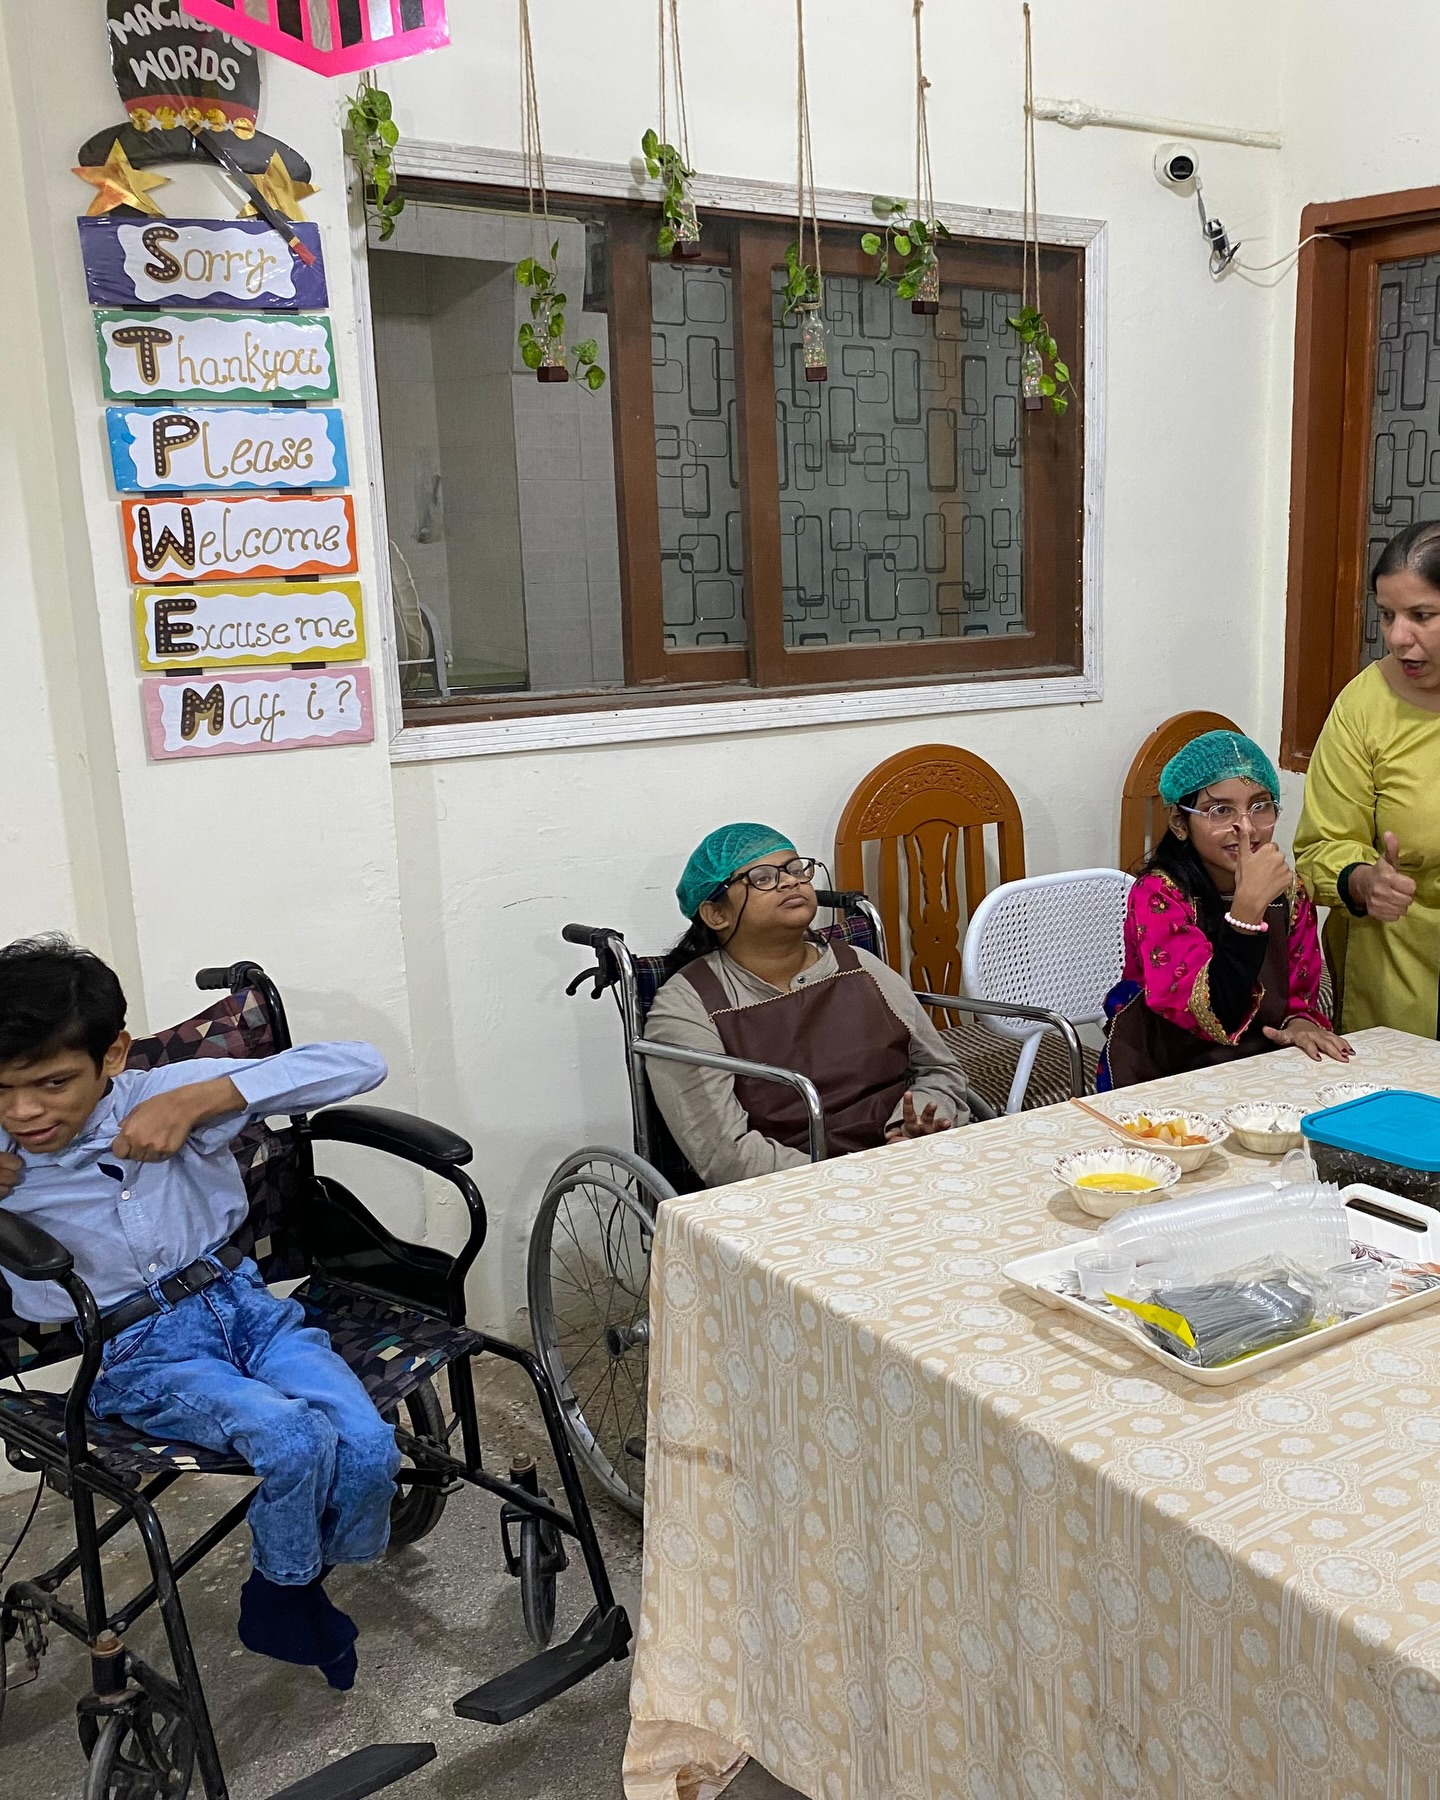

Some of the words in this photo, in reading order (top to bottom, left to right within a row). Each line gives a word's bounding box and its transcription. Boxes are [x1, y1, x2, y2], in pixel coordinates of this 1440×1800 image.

[129, 45, 240, 91] WORDS
[142, 226, 277, 294] Sorry
[152, 415, 314, 479] Please
[138, 506, 341, 572] Welcome
[181, 683, 286, 742] May
